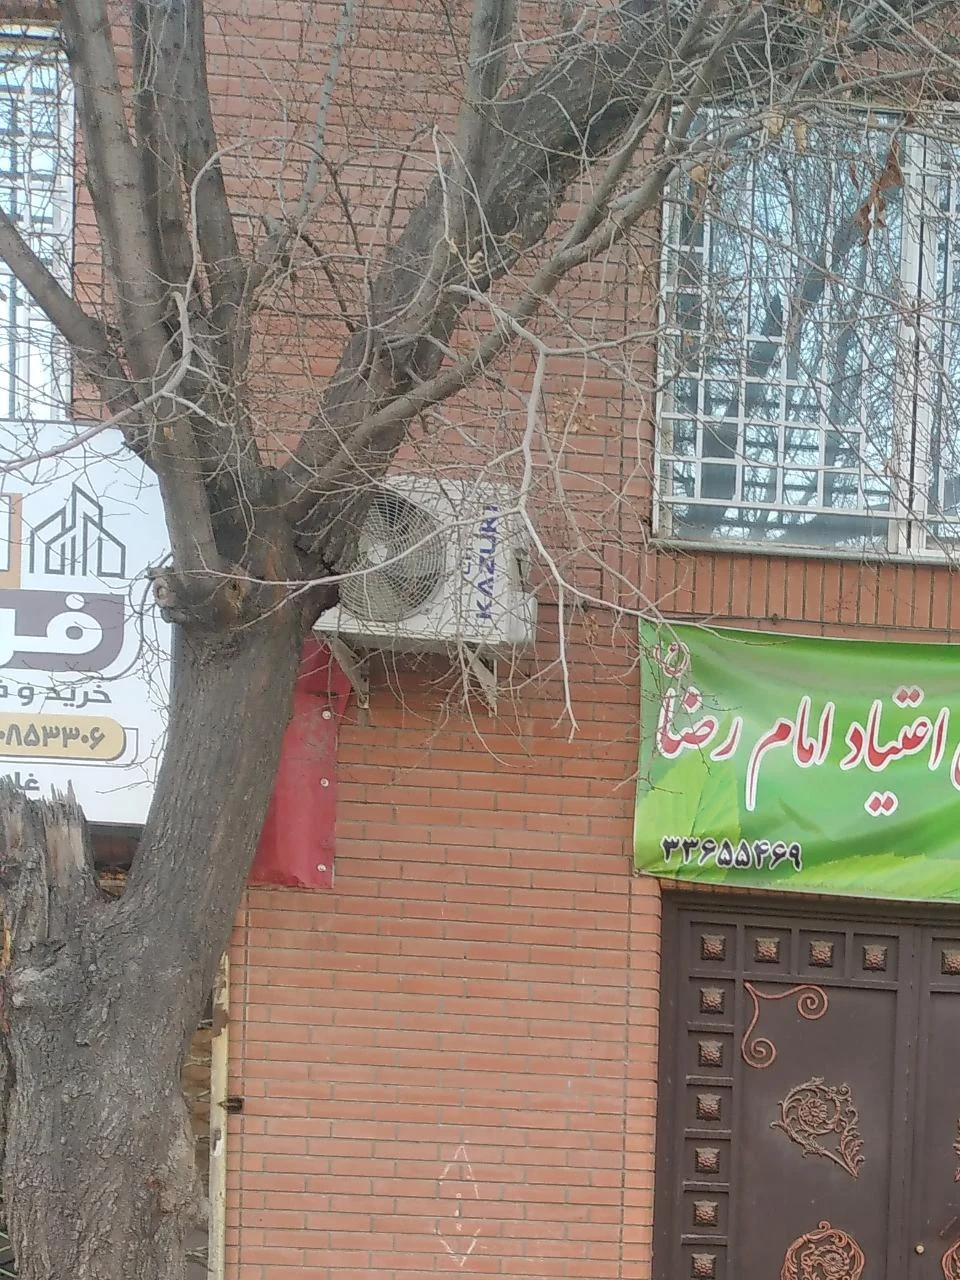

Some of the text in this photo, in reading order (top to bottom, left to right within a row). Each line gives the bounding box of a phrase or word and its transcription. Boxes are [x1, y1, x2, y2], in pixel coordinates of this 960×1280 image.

[475, 505, 499, 620] KAZUKI
[18, 685, 34, 707] و
[44, 684, 112, 709] خرید
[656, 686, 744, 760] رضا
[745, 695, 836, 812] امام
[840, 686, 950, 816] اعتیاد
[661, 835, 803, 873] ۳۳۶۵۵۴۶۹
